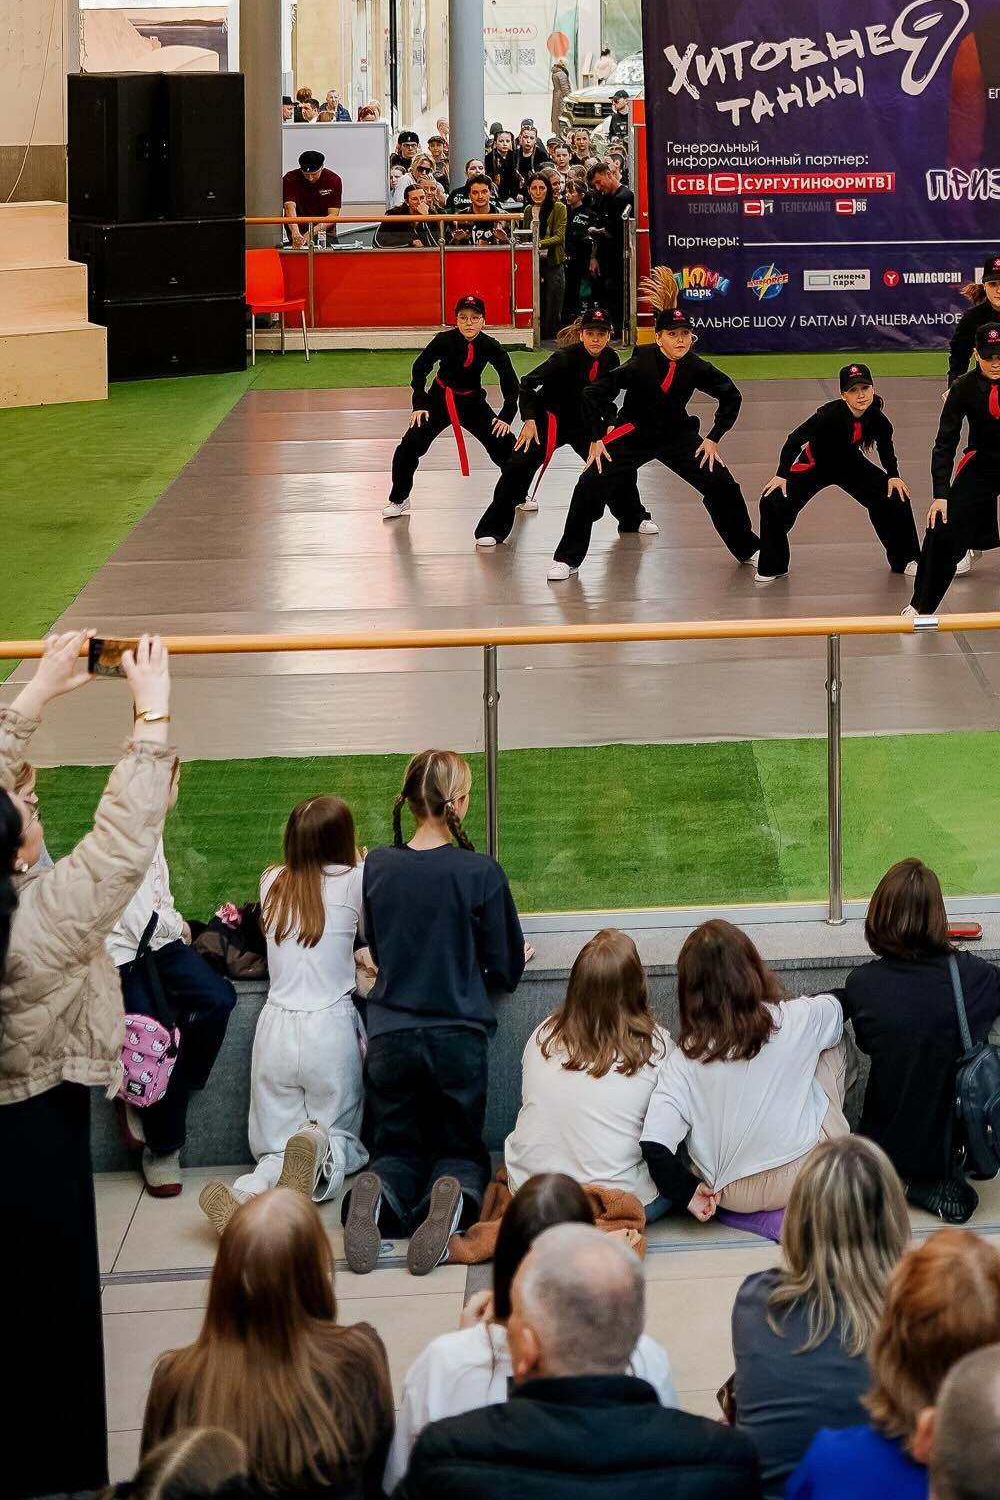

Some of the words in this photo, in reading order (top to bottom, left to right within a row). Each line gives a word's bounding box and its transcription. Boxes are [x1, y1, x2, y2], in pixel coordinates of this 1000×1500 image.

[664, 24, 900, 100] ХИТОВЫЕ
[716, 66, 865, 127] ТАНЦЫ
[666, 140, 760, 156] Генеральный
[666, 153, 802, 169] информационный
[805, 153, 869, 168] партнер:
[688, 202, 739, 214] ТЕЛЕКАНАЛ
[781, 201, 831, 213] ТЕЛЕКАНАЛ
[668, 234, 740, 249] Партнеры:
[832, 273, 866, 281] синема
[832, 279, 856, 287] парк
[902, 272, 962, 285] YAMAGUCHI
[685, 288, 712, 299] парк
[753, 315, 786, 328] ШОУ
[799, 313, 848, 327] БАТТЛЫ
[860, 312, 962, 327] ТАНЦЕВАЛЬНОЕ
